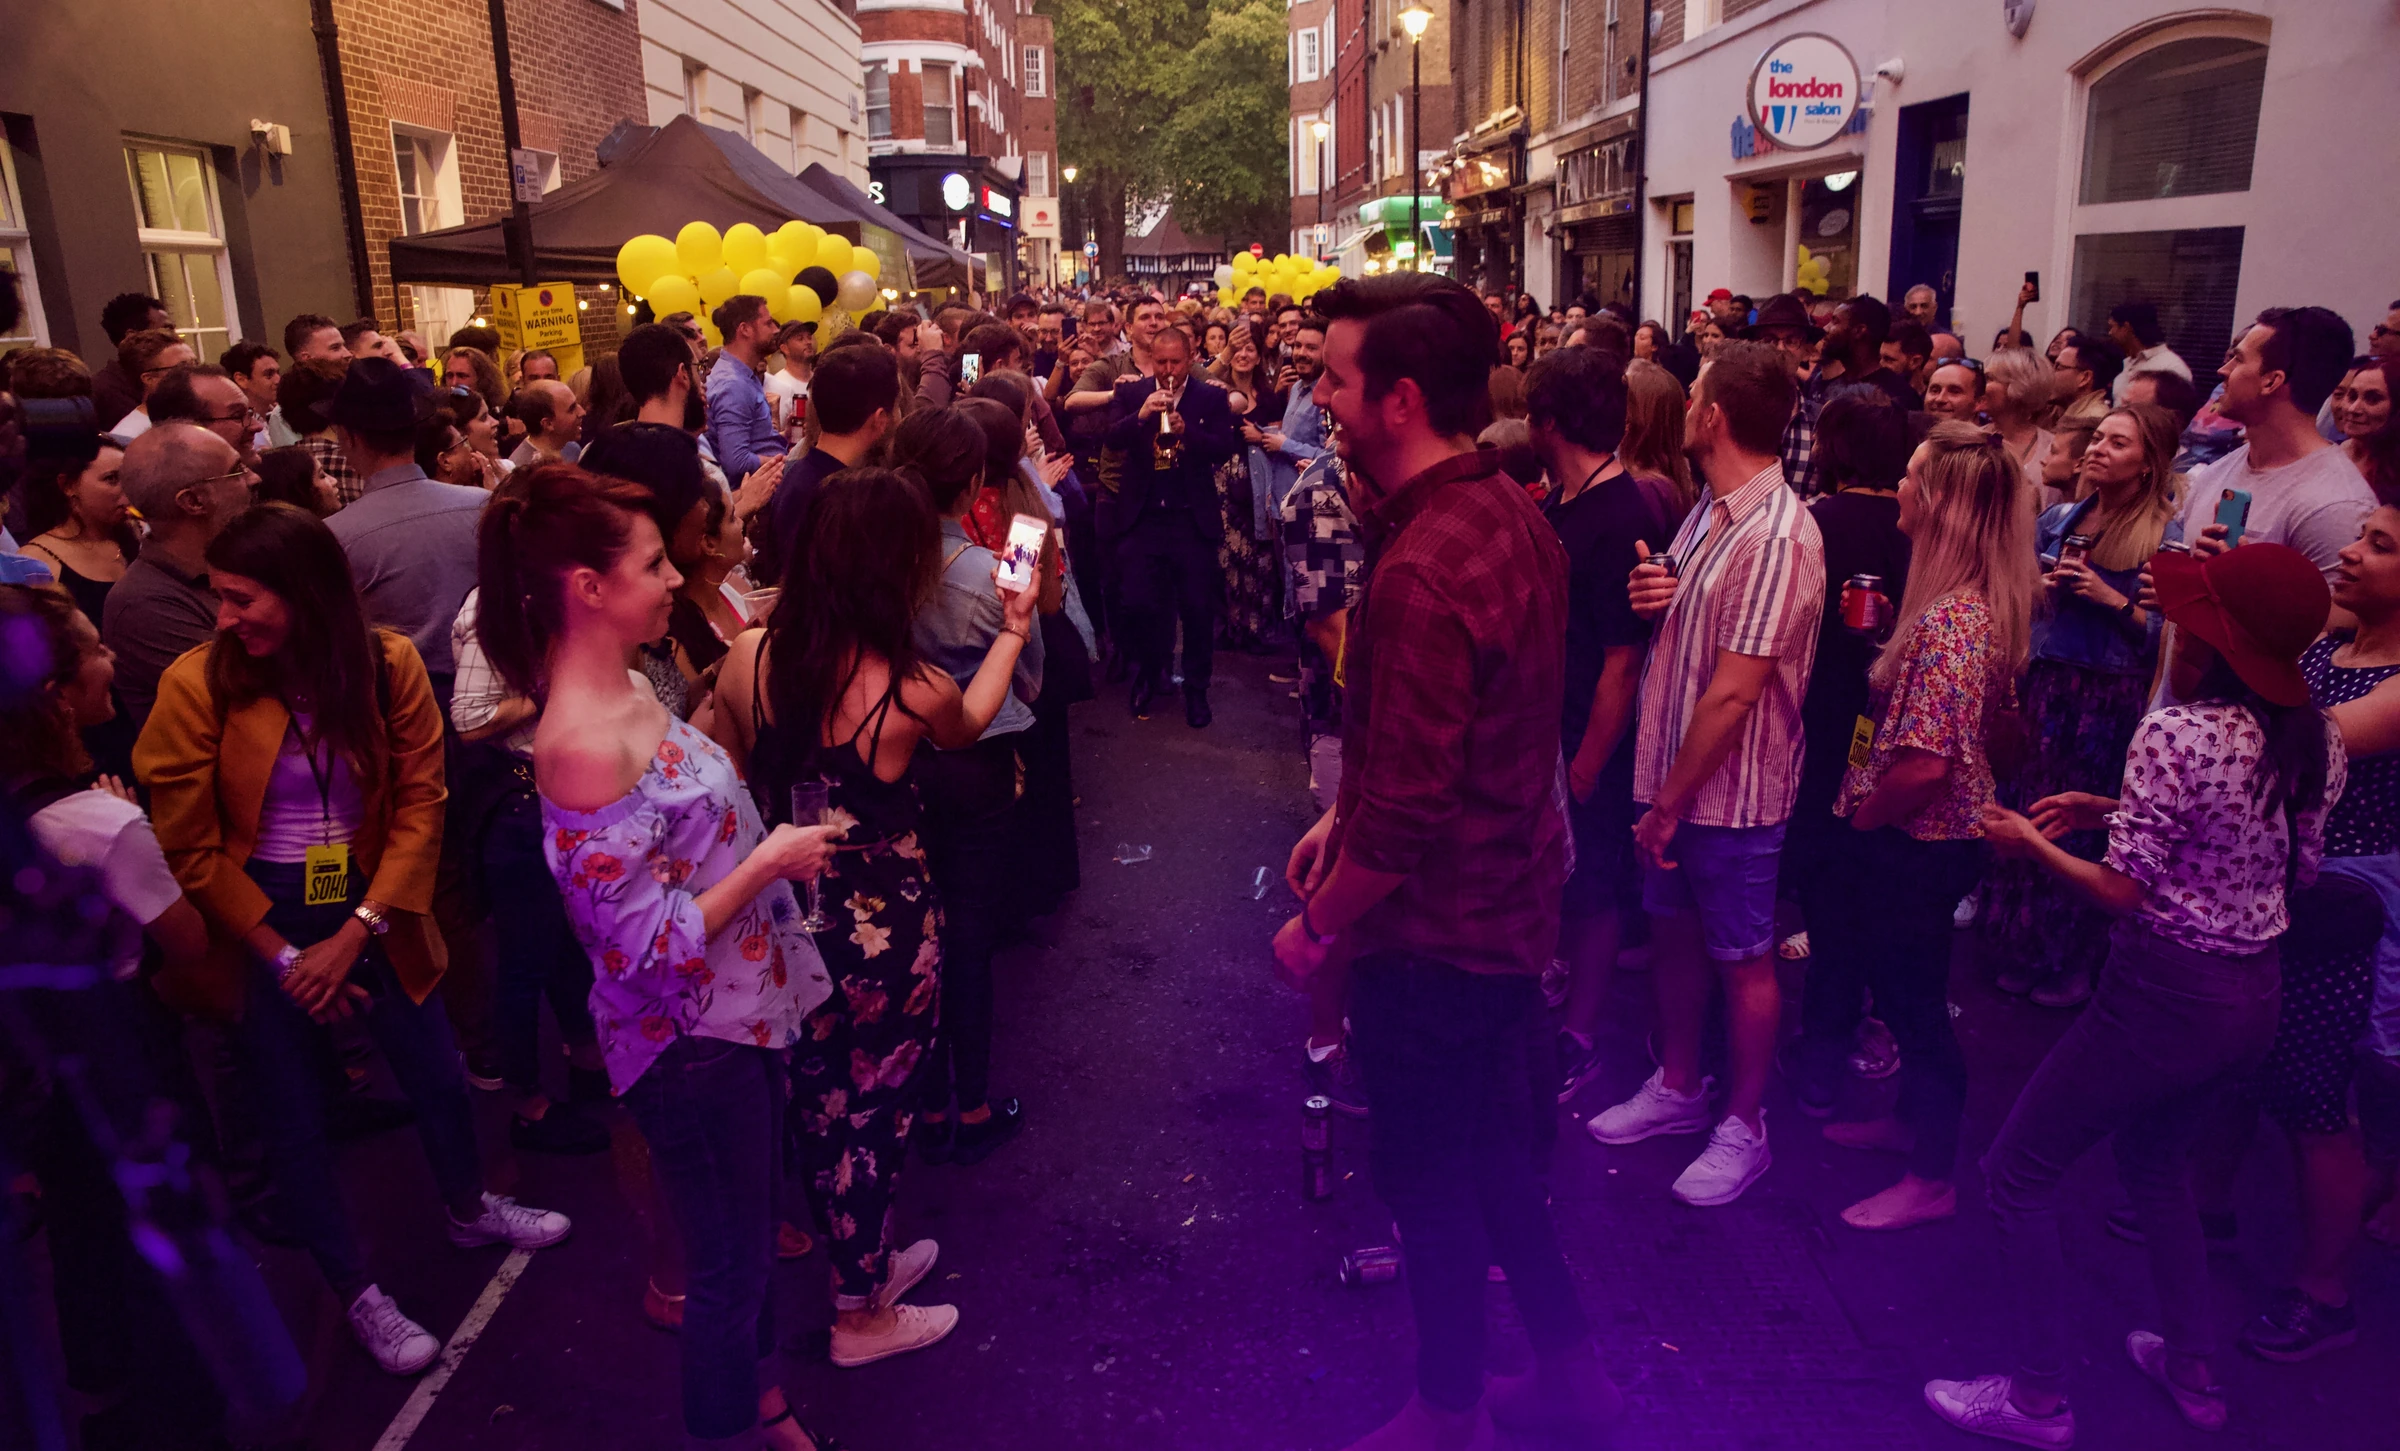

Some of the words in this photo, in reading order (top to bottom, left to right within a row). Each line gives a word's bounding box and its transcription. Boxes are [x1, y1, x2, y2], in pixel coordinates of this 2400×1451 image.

[1770, 59, 1793, 74] the
[1769, 76, 1843, 99] london
[1805, 102, 1841, 116] salon
[540, 309, 550, 317] any
[551, 307, 563, 315] time
[525, 314, 574, 330] WARNING
[540, 329, 563, 337] Parking
[536, 337, 569, 347] suspension
